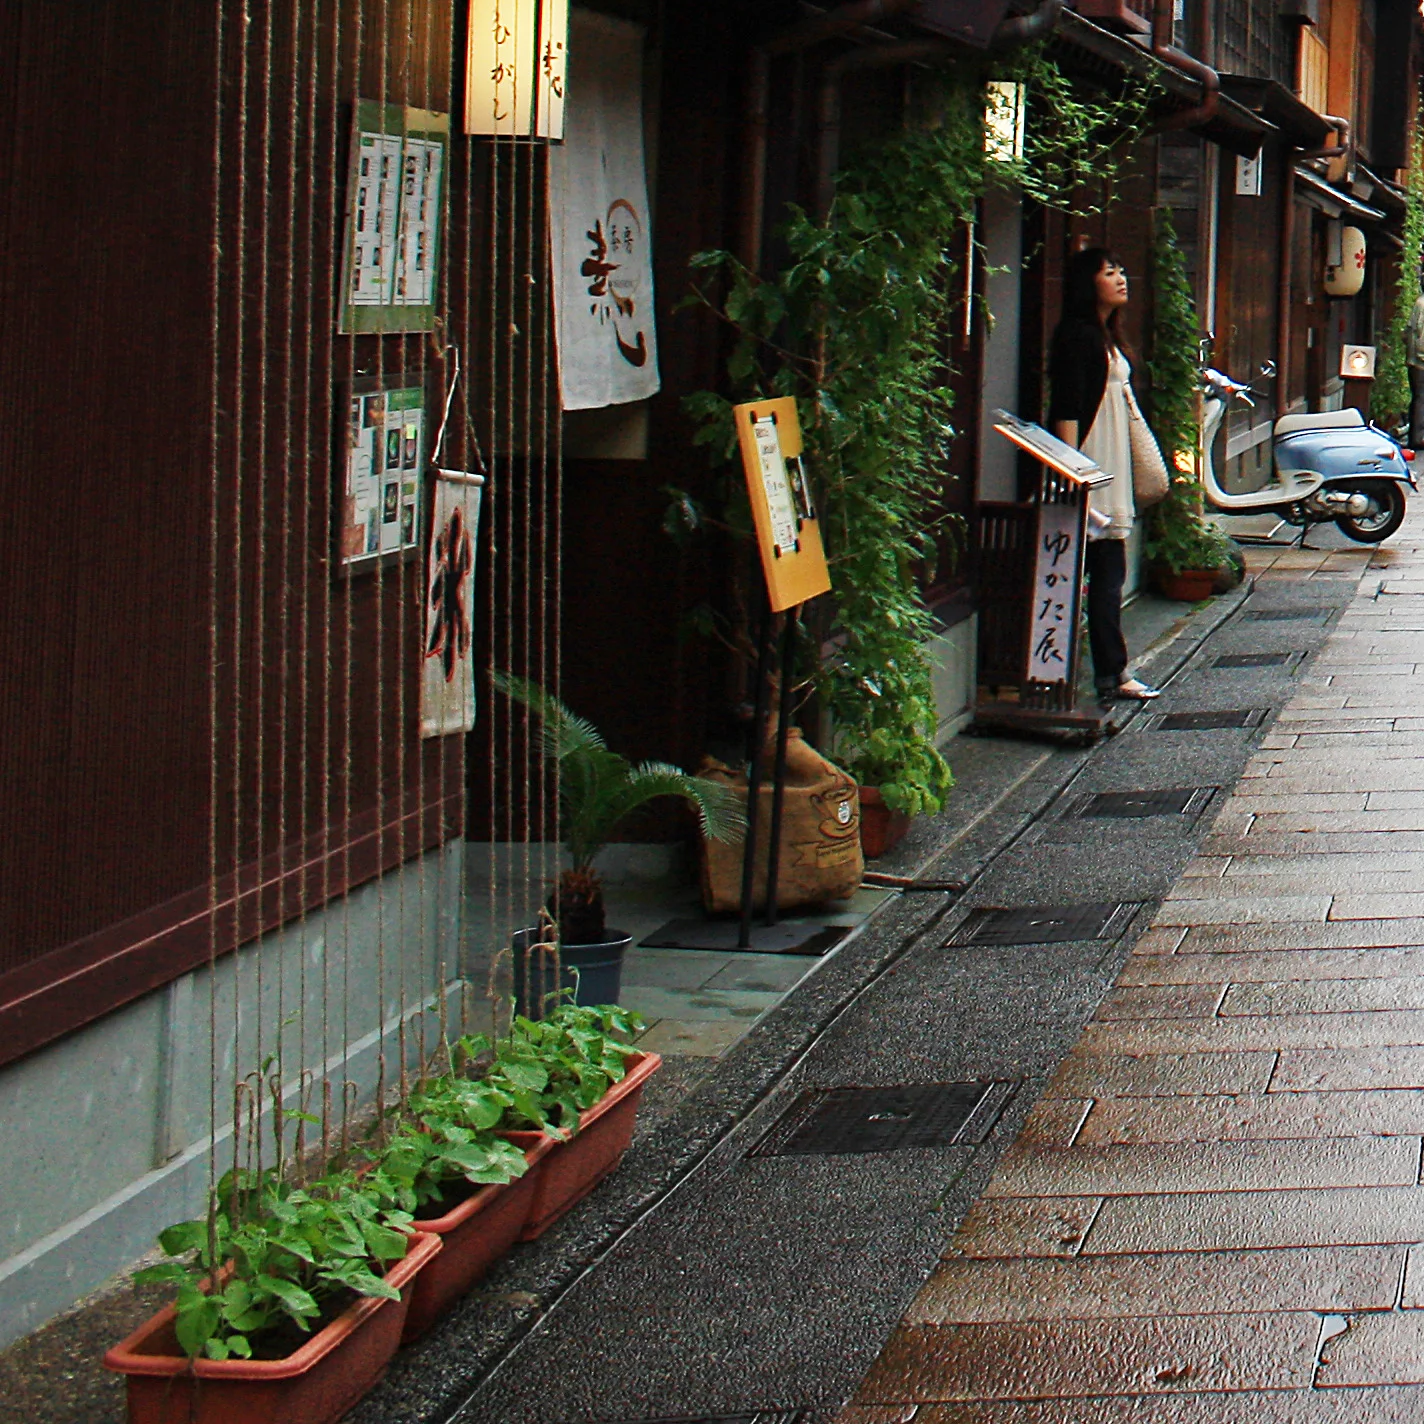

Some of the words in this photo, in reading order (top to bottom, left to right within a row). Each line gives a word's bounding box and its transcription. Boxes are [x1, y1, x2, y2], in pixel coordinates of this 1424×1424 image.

[490, 12, 514, 120] ひがし
[1034, 533, 1071, 664] ゆかた展
